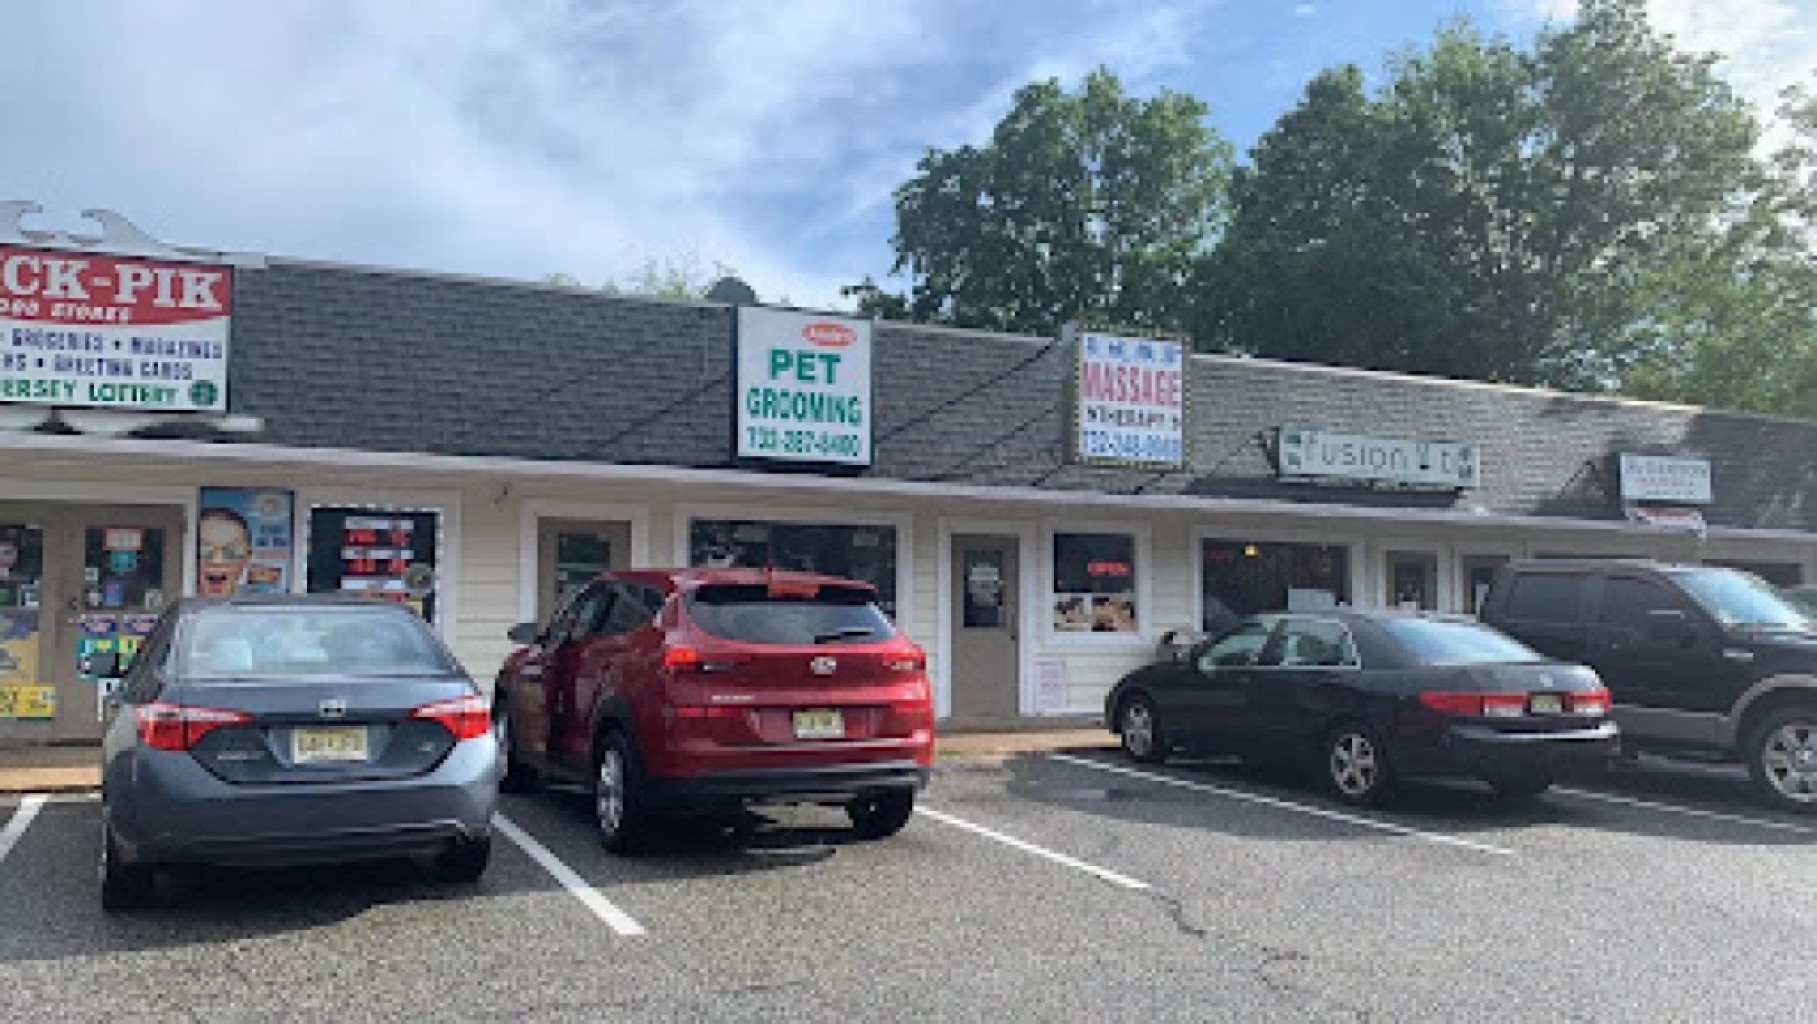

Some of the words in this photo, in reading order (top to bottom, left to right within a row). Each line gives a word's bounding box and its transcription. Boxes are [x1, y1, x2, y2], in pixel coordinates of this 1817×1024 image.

[3, 255, 223, 311] CK-PIK
[141, 361, 193, 380] CARDS
[768, 349, 841, 384] PET
[1082, 362, 1183, 408] MASSAGE
[89, 383, 178, 402] LOTTERY
[746, 387, 863, 426] GROOMING
